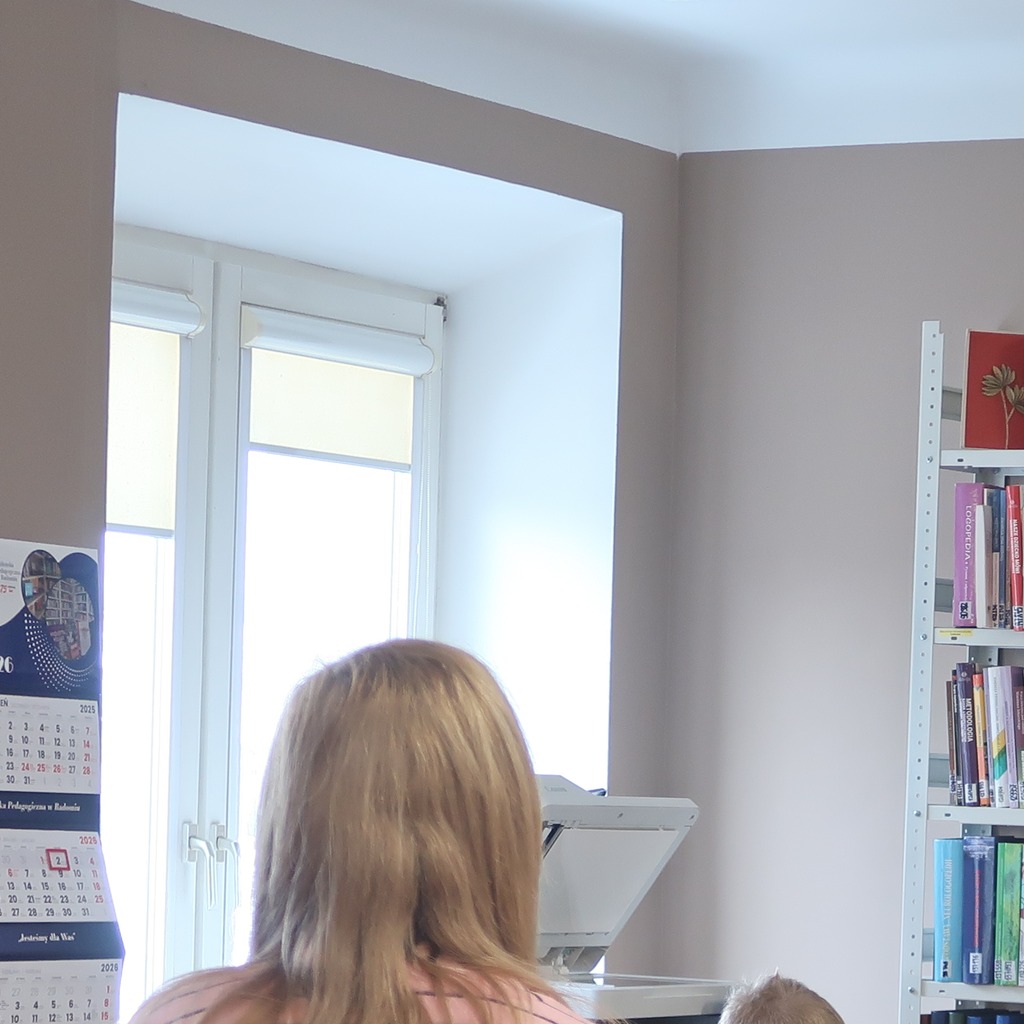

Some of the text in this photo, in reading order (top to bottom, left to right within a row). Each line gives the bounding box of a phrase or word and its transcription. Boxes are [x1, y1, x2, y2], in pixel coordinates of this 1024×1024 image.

[963, 505, 972, 561] LOGOPEDIA
[80, 705, 95, 713] 2025
[966, 698, 974, 742] METODOLOGIA
[22, 736, 28, 744] 10
[39, 737, 44, 745] 11
[54, 738, 60, 746] 12
[69, 739, 75, 747] 13
[6, 748, 13, 757] 16
[23, 749, 29, 757] 17
[38, 750, 45, 758] 18
[54, 751, 61, 759] 19
[68, 752, 75, 760] 20
[6, 762, 14, 770] 23
[22, 763, 29, 771] 24
[37, 764, 45, 772] 25
[53, 764, 61, 773] 26
[69, 766, 76, 774] 27
[7, 775, 30, 784] 30 31
[8, 802, 46, 812] Pedagogiczna
[54, 802, 80, 812] Radomiu
[79, 836, 97, 844] 2026
[73, 869, 81, 877] 10
[7, 882, 15, 890] 13
[24, 882, 32, 890] 14
[41, 882, 49, 890] 15
[58, 882, 66, 890] 16
[77, 882, 83, 890] 17
[8, 895, 17, 903] 20
[27, 895, 34, 903] 21
[43, 895, 52, 903] 22
[60, 895, 69, 903] 23
[77, 895, 86, 903] 24
[11, 908, 19, 916] 27
[28, 908, 37, 916] 28
[46, 908, 54, 916] 29
[62, 908, 72, 916] 30
[49, 933, 60, 941] dla
[101, 963, 118, 972] 2026
[11, 1015, 19, 1023] 10
[32, 1014, 38, 1022] 11
[49, 1014, 56, 1022] 12
[66, 1013, 73, 1021] 13
